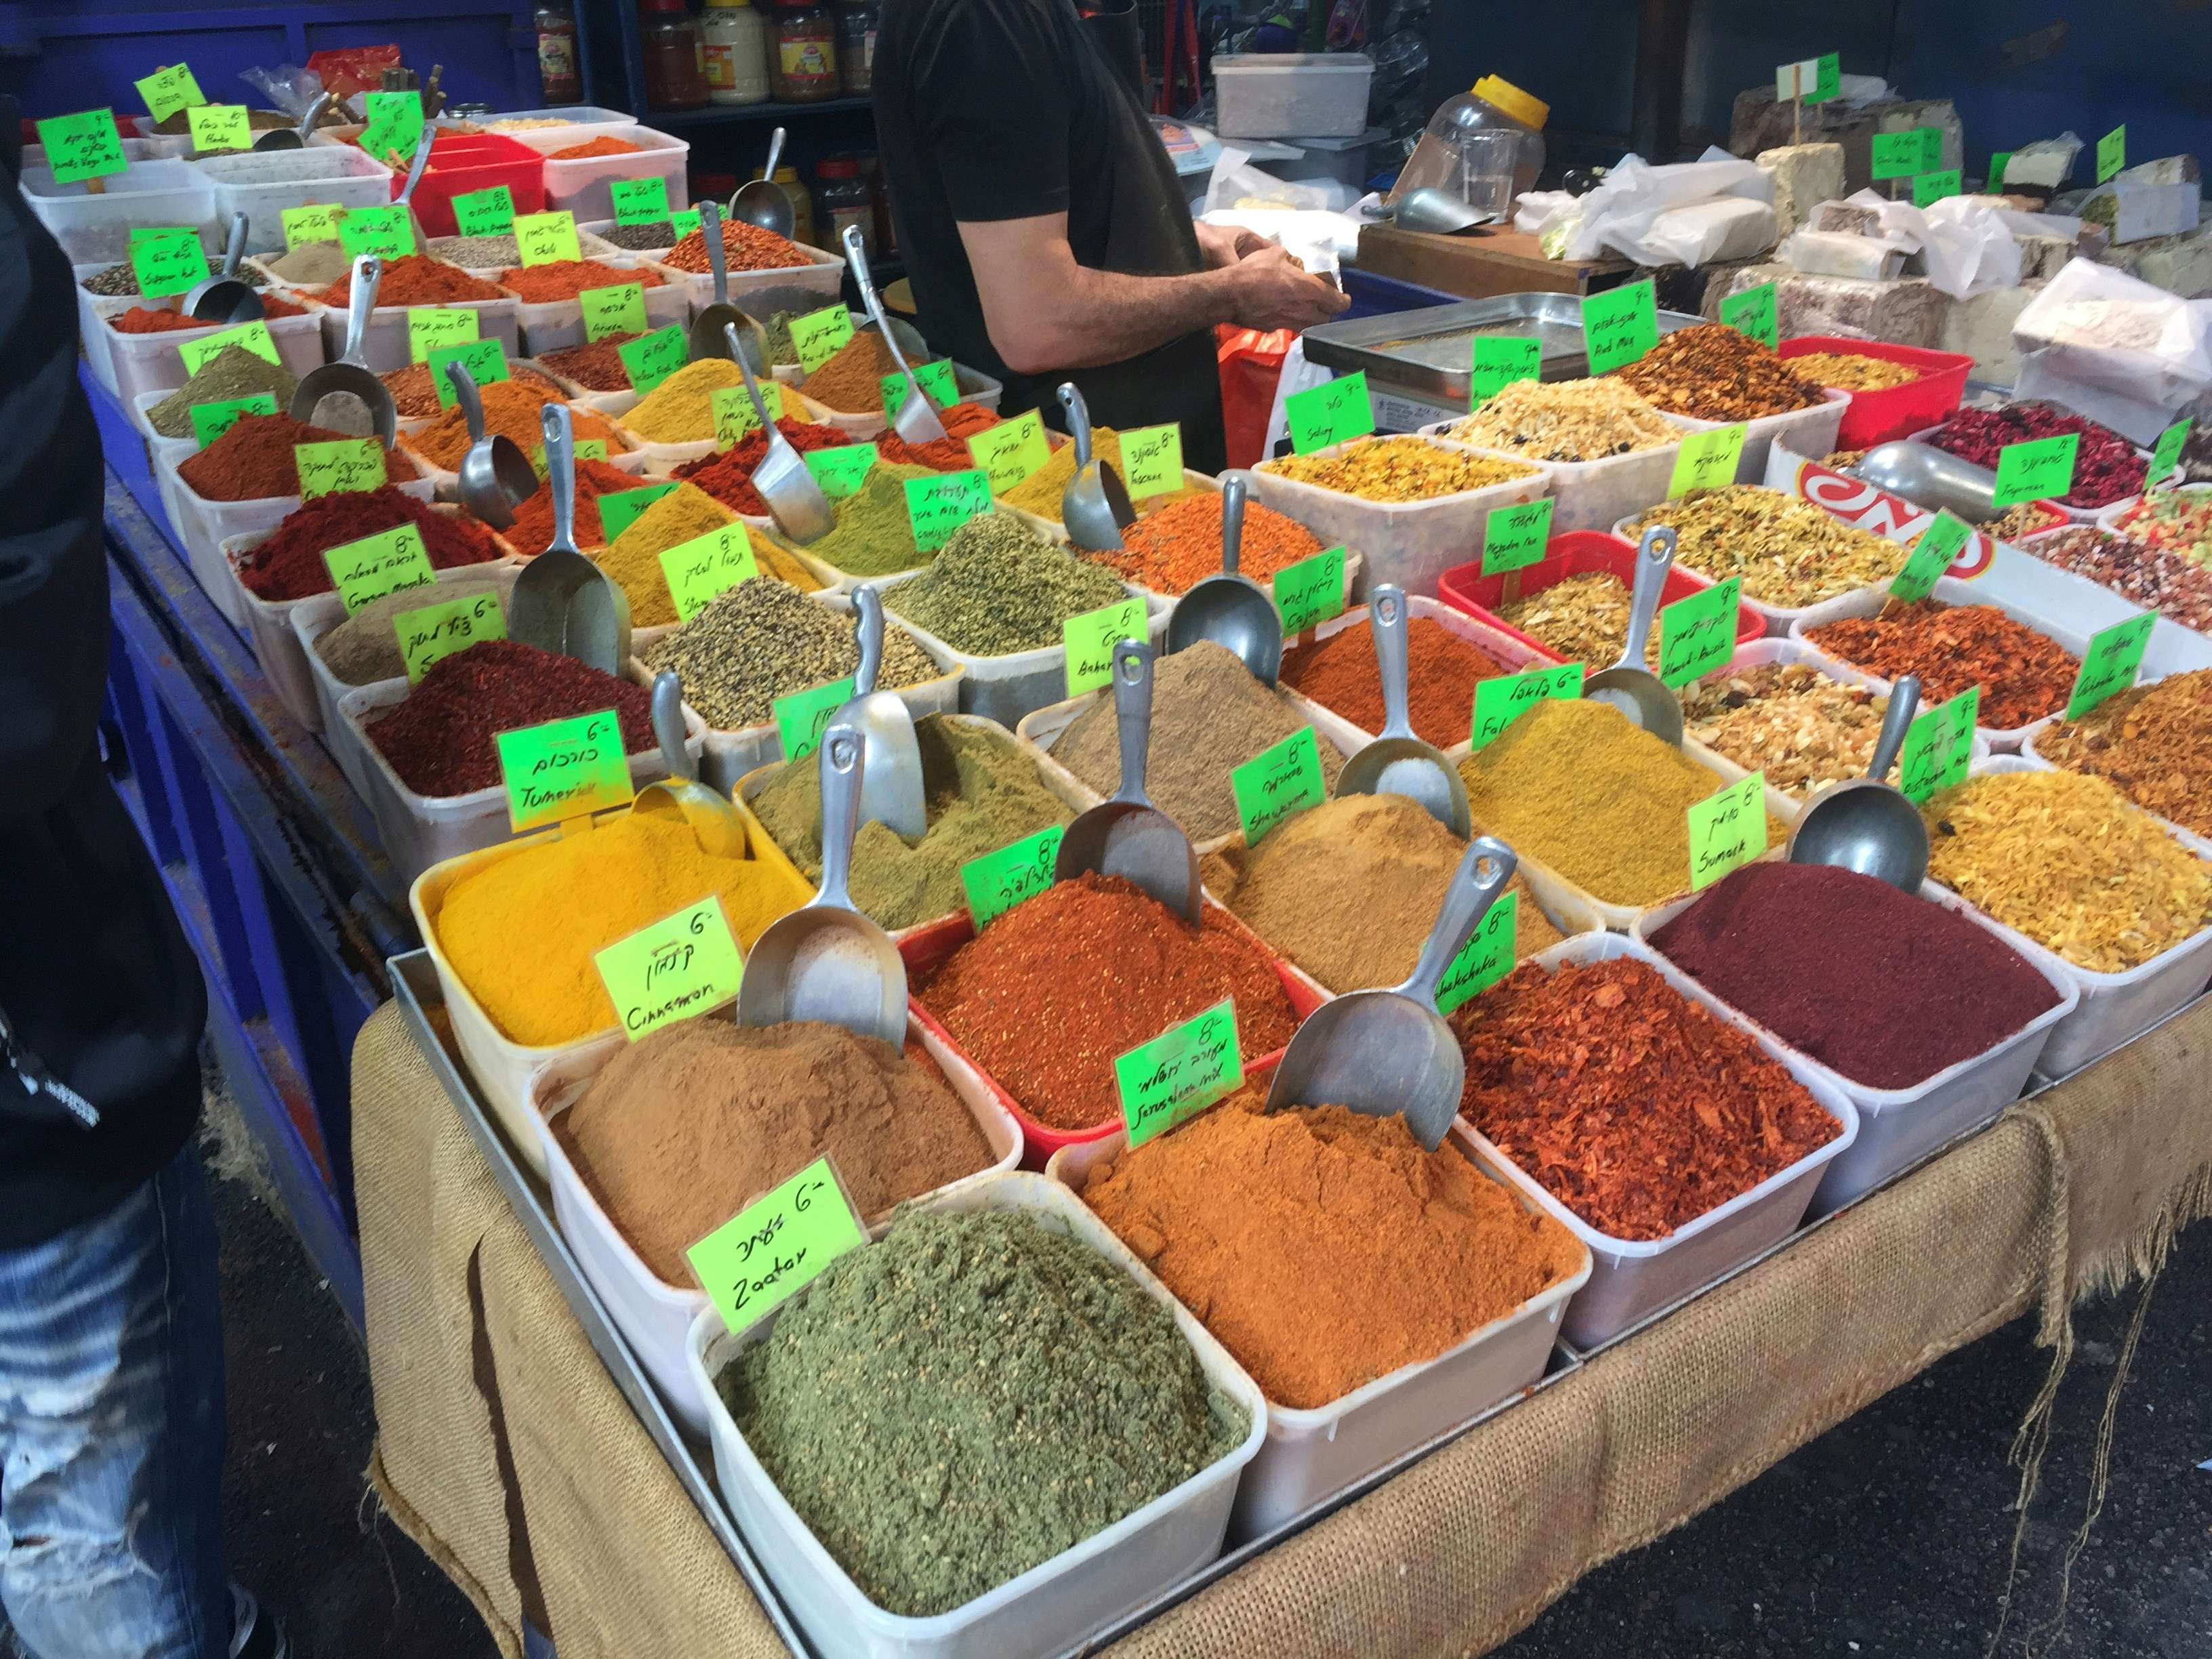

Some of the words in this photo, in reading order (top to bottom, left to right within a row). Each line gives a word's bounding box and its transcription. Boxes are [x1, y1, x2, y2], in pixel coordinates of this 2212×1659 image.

[532, 749, 598, 775] כורכום
[627, 983, 714, 1031] Cinnamon
[733, 1248, 806, 1310] Zaatar
